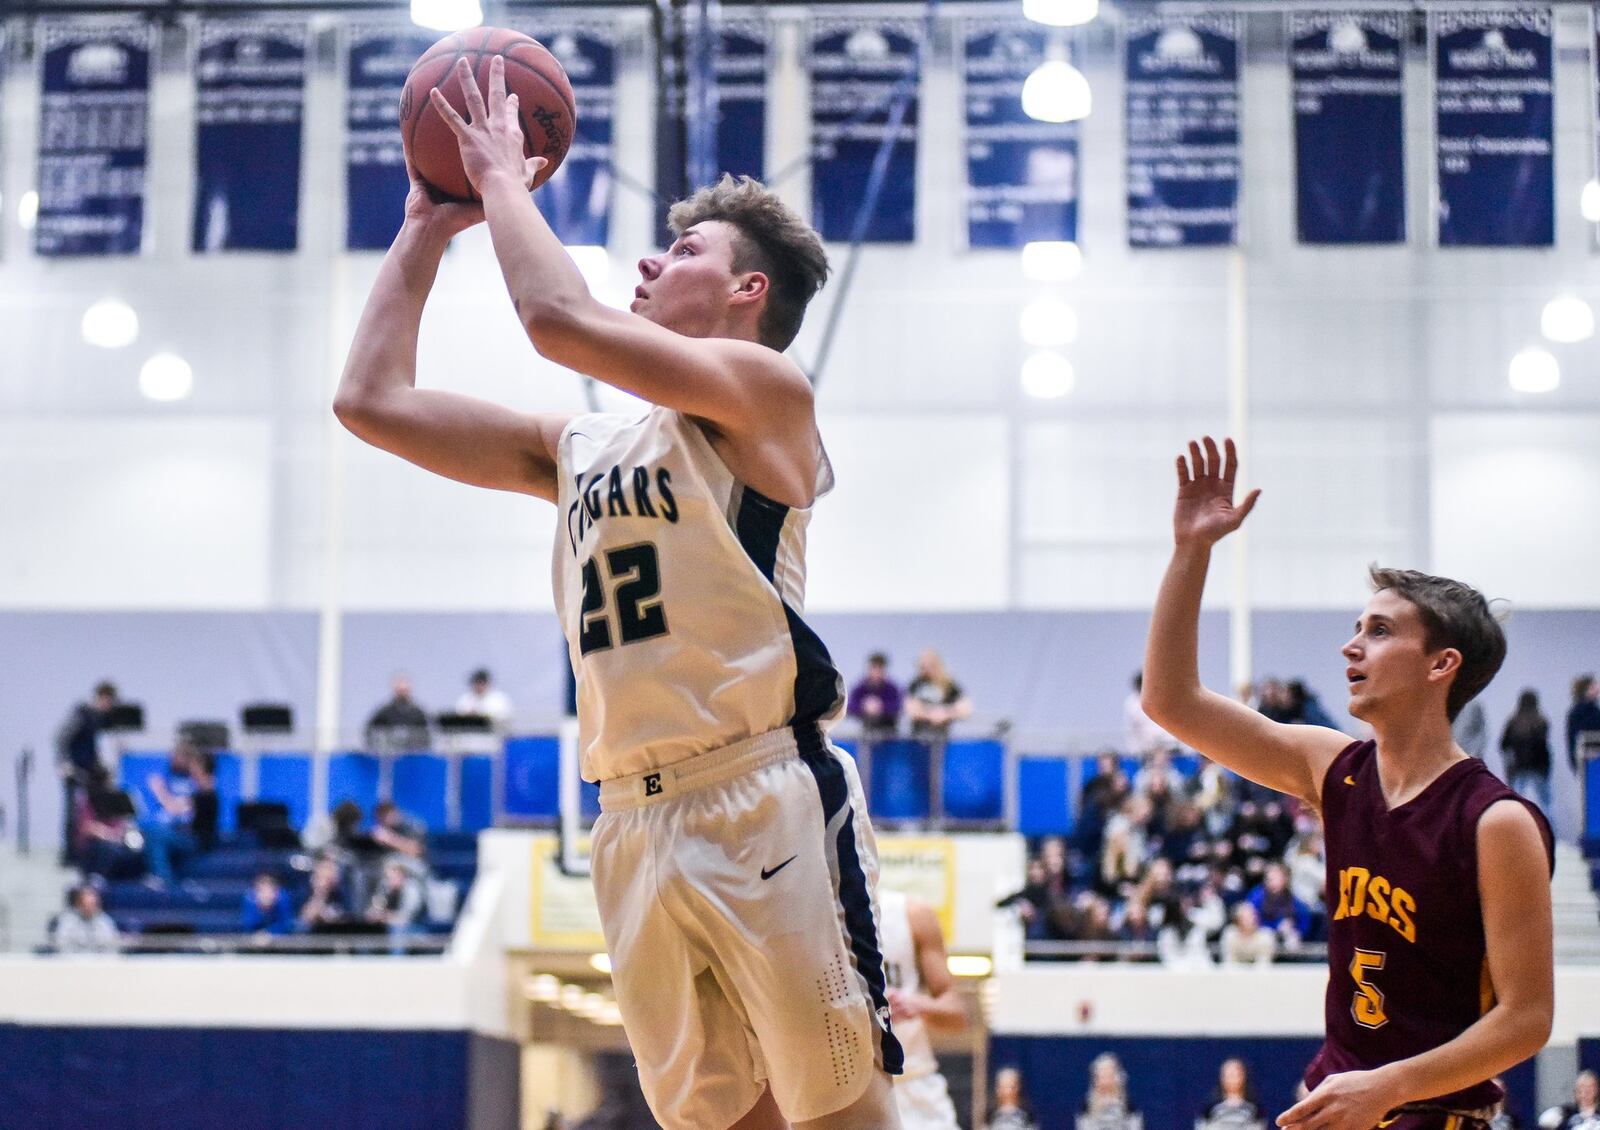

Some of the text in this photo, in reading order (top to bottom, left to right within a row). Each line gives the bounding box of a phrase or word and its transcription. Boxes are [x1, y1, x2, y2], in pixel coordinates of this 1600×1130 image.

[580, 540, 670, 656] 22
[643, 772, 663, 796] E
[1349, 947, 1390, 1029] 5
